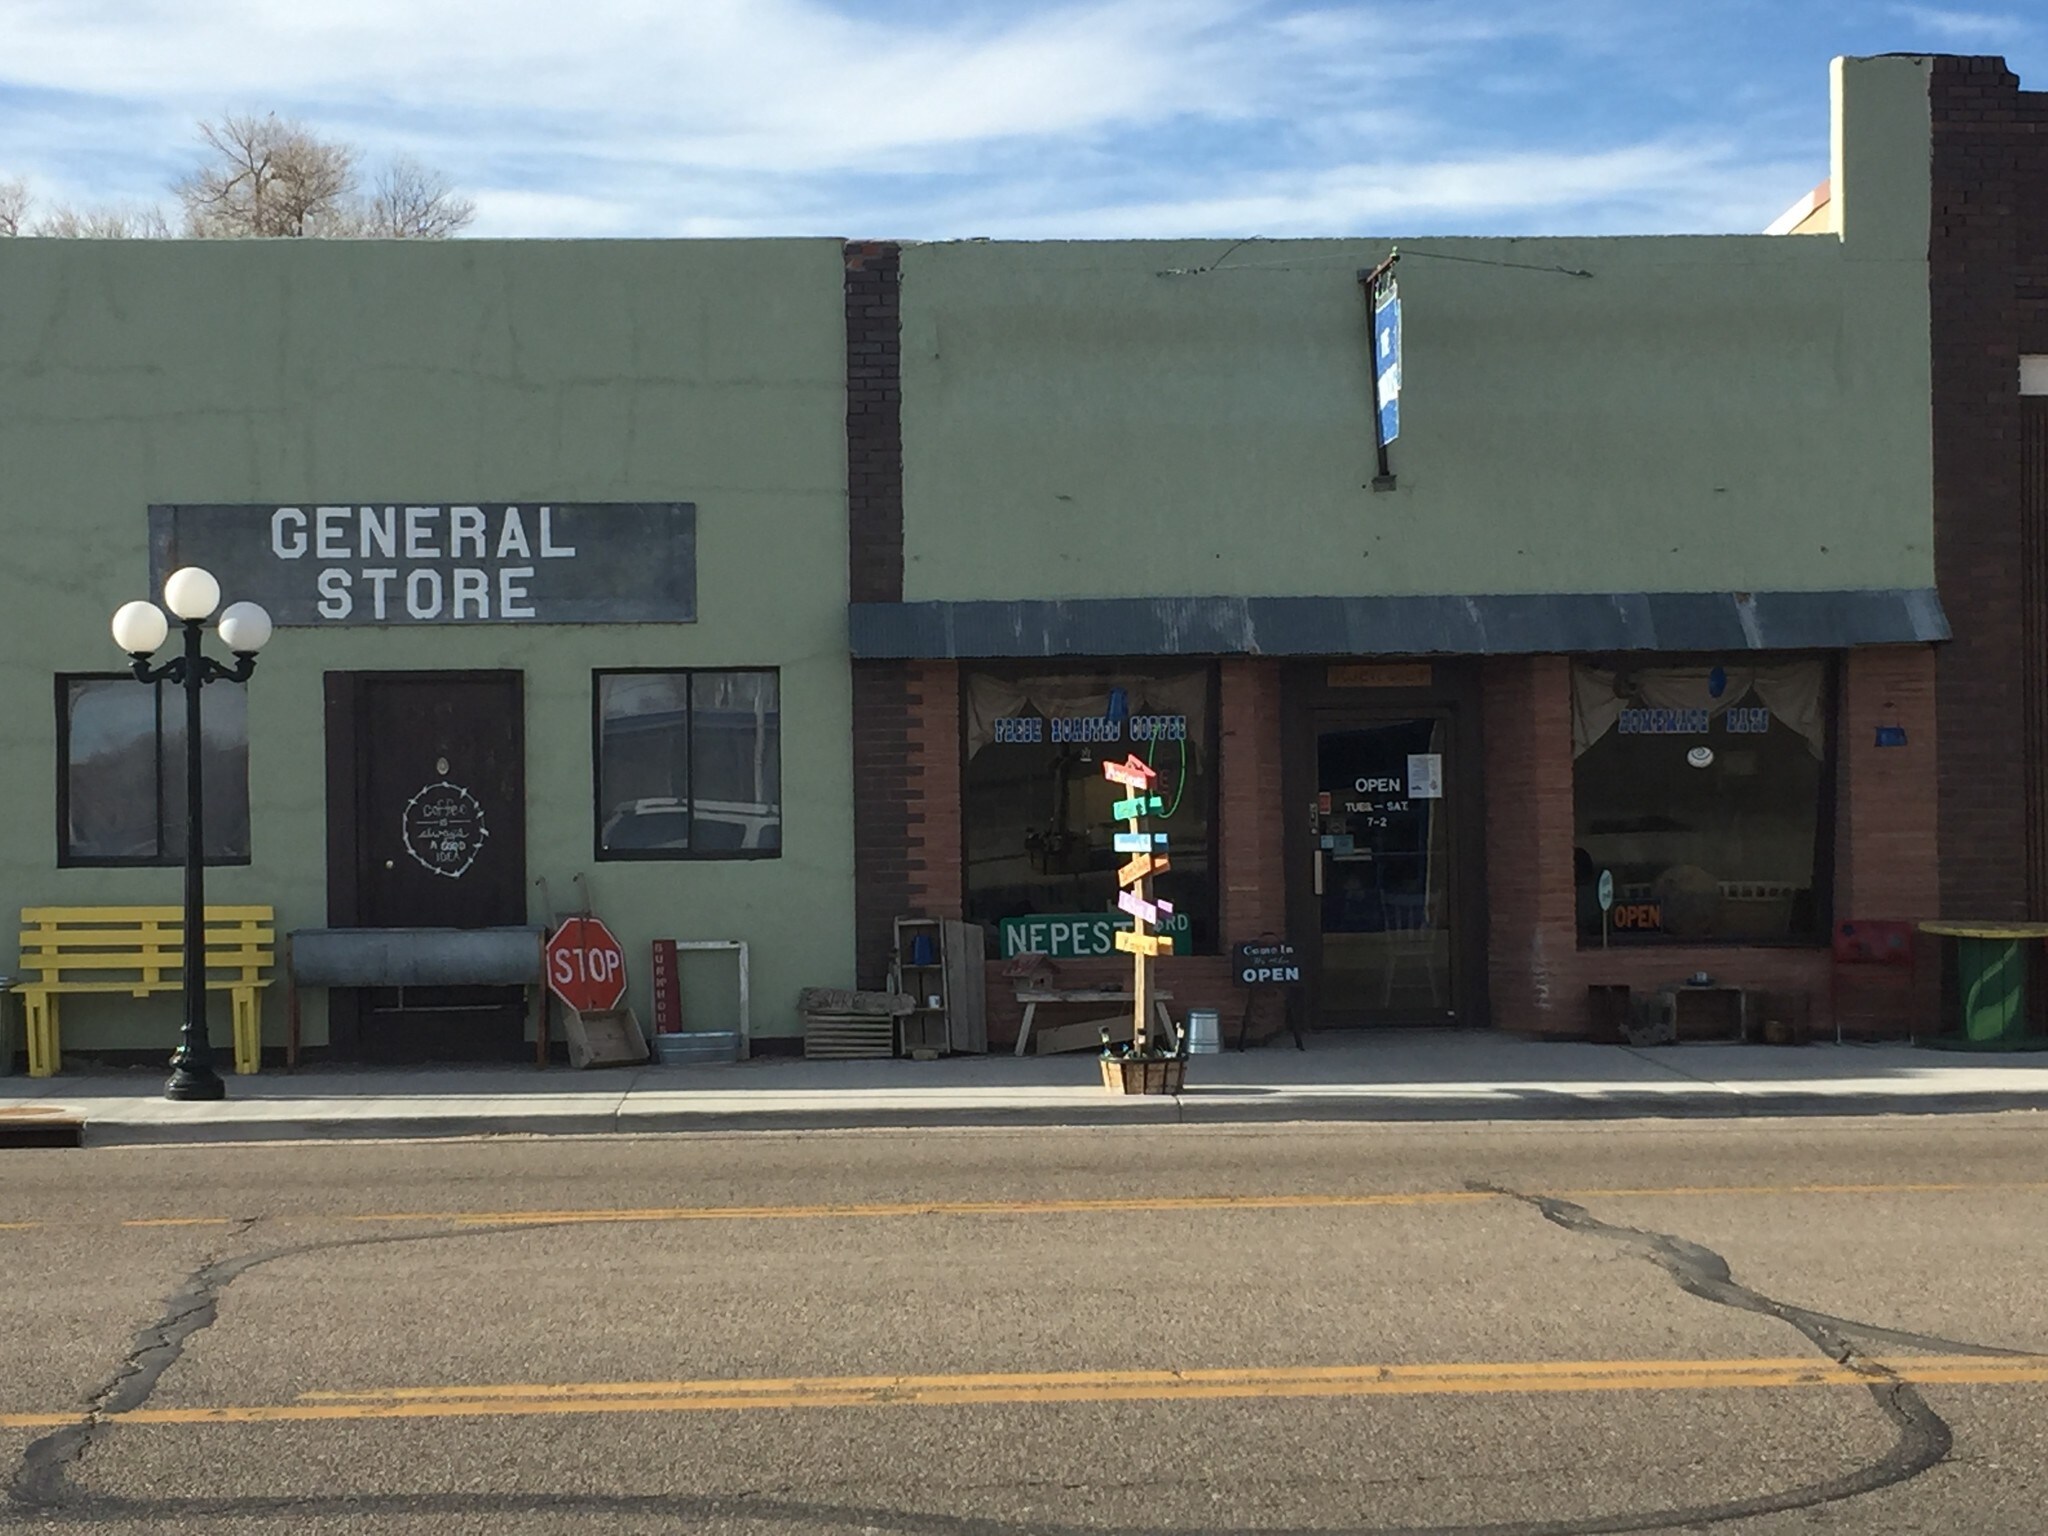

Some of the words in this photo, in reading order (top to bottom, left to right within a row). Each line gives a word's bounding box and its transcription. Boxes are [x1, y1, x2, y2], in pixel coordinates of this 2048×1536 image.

[271, 506, 576, 559] GENERAL
[317, 566, 536, 619] STORE
[995, 717, 1042, 742] FRESH
[1051, 717, 1121, 742] ROASTED
[1129, 715, 1187, 741] COFFEE
[1355, 778, 1401, 792] OPEN
[1615, 905, 1660, 928] OPEN
[1007, 921, 1137, 956] NEPEST
[555, 947, 620, 984] STOP
[1242, 967, 1300, 982] OPEN
